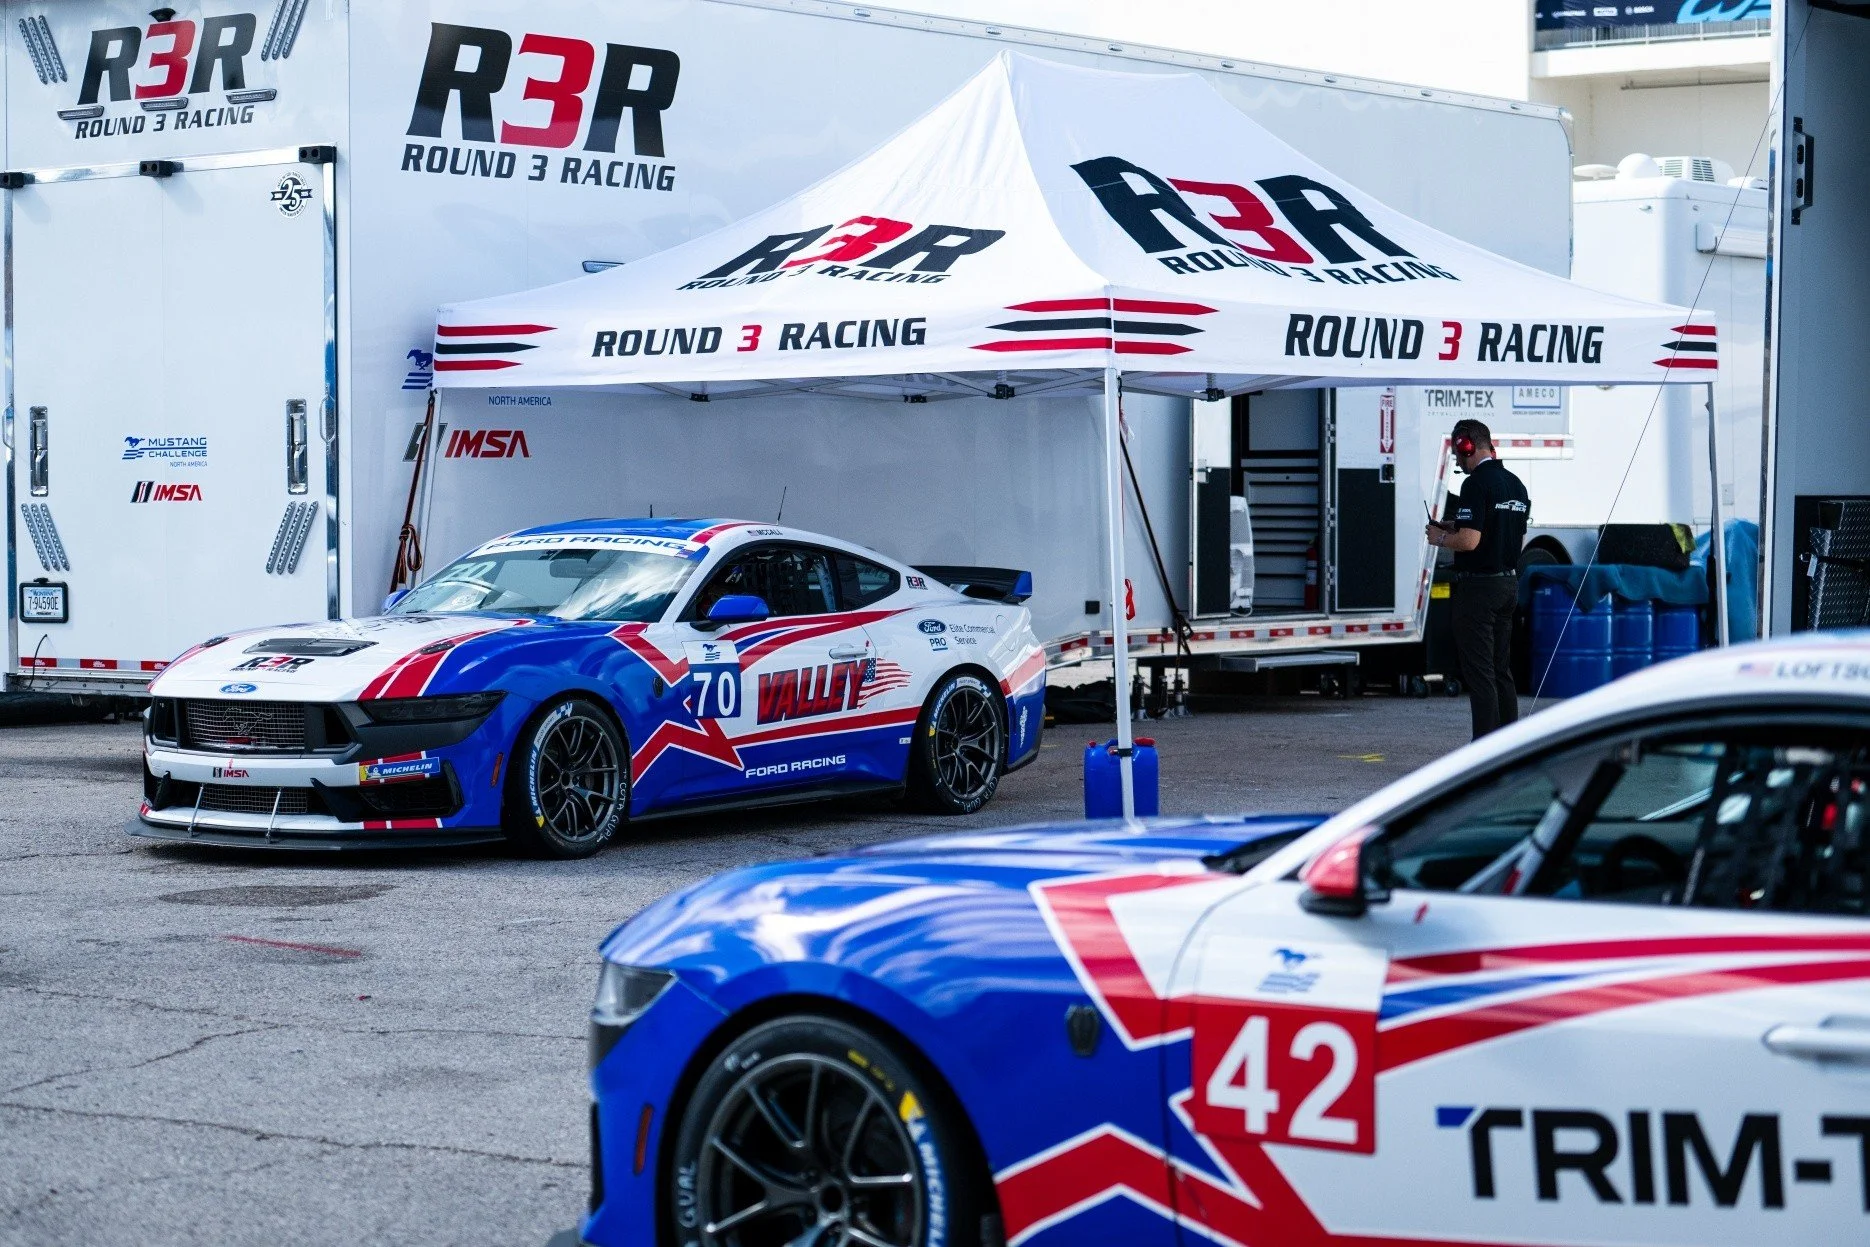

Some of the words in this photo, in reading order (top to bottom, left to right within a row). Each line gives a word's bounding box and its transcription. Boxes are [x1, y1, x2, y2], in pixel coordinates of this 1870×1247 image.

[77, 13, 256, 105] R3R
[406, 22, 680, 157] R3R
[75, 115, 145, 139] ROUND
[153, 113, 166, 132] 3
[174, 105, 254, 130] RACING
[401, 144, 516, 179] ROUND
[528, 154, 548, 181] 3
[560, 157, 676, 192] RACING
[279, 179, 301, 210] 25
[1069, 156, 1418, 264] R3R
[696, 215, 1006, 279] R3R
[675, 270, 784, 291] ROUND
[788, 264, 815, 277] 3
[817, 265, 951, 284] RACING
[1157, 249, 1291, 277] ROUND
[1290, 266, 1325, 282] 3
[1322, 256, 1462, 285] RACING
[592, 326, 722, 357] ROUND
[737, 324, 762, 352] 3
[778, 317, 927, 350] RACING
[1284, 313, 1424, 362] ROUND
[1437, 321, 1460, 361] 3
[1477, 322, 1604, 363] RACING
[488, 395, 516, 406] NORTH
[518, 396, 551, 406] AMERICA
[1424, 389, 1494, 408] TRIM-TEX
[1519, 388, 1554, 397] AMECO
[148, 437, 207, 446] MUSTANG
[445, 430, 530, 457] IMSA
[153, 484, 202, 501] IMSA
[486, 537, 562, 550] FORD
[569, 537, 686, 550] RACING
[906, 576, 927, 588] R3R
[923, 621, 941, 632] Ford
[949, 624, 963, 632] Elite
[963, 624, 996, 634] Commercial
[930, 637, 946, 646] PRO
[954, 636, 977, 645] Service
[237, 656, 315, 670] R3R
[693, 671, 736, 717] 70
[757, 658, 870, 725] VALLEY
[223, 769, 249, 777] IMSA
[382, 763, 432, 774] MICHELIN
[529, 750, 538, 806] MICHELIN
[745, 763, 788, 778] FORD
[791, 755, 846, 772] RACING
[1206, 1015, 1359, 1145] 42
